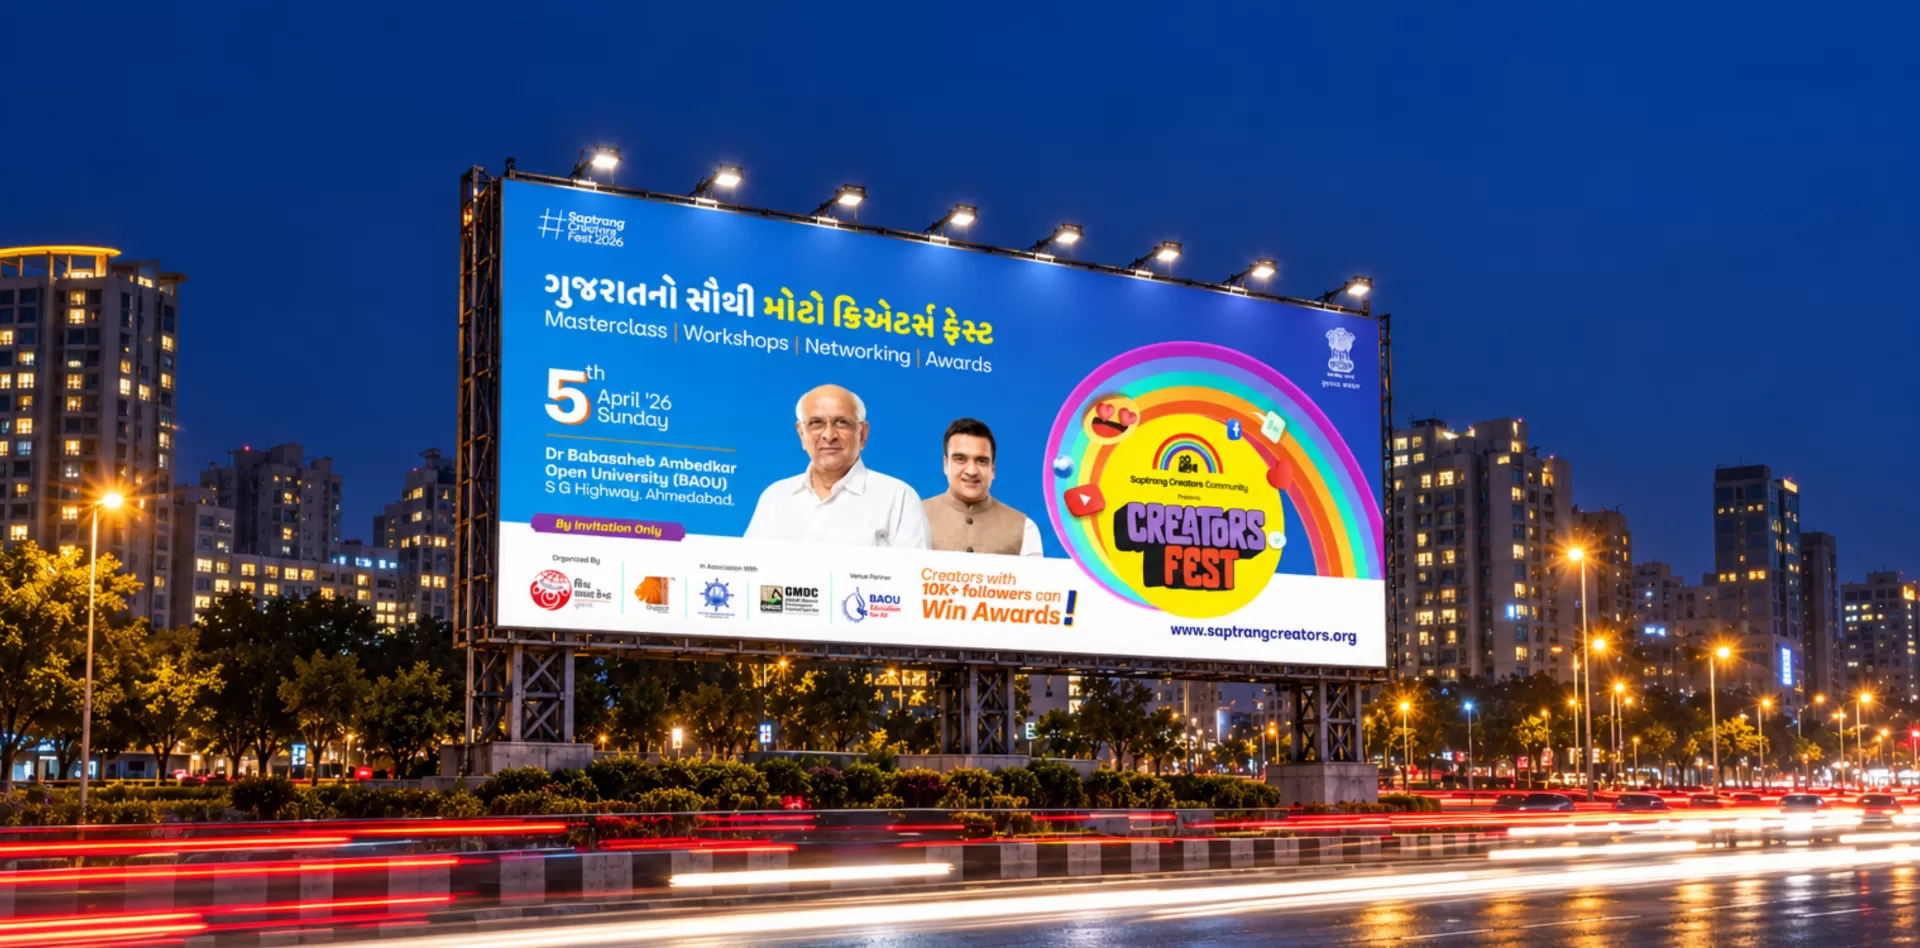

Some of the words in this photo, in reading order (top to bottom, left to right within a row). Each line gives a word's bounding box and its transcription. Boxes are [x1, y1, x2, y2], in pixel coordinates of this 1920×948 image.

[568, 211, 625, 231] Saptrang
[568, 231, 593, 244] Fest
[594, 234, 624, 247] 2026
[544, 273, 677, 309] ગુજરાતનો
[686, 277, 755, 318] સૌથી
[763, 286, 824, 325] મોટો
[833, 295, 936, 338] ક્રિએટર્સ
[942, 307, 994, 346] ફેસ્ટ
[545, 310, 668, 339] Masterclass
[683, 324, 789, 353] Workshops
[805, 338, 910, 368] Networking
[925, 351, 992, 373] Awards
[545, 368, 591, 425] 5
[585, 364, 605, 380] th
[597, 389, 640, 408] April
[645, 392, 672, 411] '26
[597, 407, 669, 431] Sunday
[545, 447, 564, 460] Dr
[567, 448, 655, 468] Babasaheb
[659, 456, 737, 474] Ambedkar
[545, 464, 587, 480] Open
[591, 467, 669, 488] University
[673, 473, 728, 491] (BAOU)
[1130, 475, 1168, 487] Saptrang
[1169, 478, 1203, 488] Creators
[1205, 481, 1248, 494] Community
[545, 481, 555, 494] S
[559, 481, 571, 495] G
[646, 489, 735, 506] Ahmedabad.
[556, 519, 572, 532] By
[574, 520, 632, 534] Invitation
[634, 524, 662, 538] Only
[590, 556, 601, 566] By
[1164, 545, 1240, 590] FEST
[921, 567, 983, 584] Creators
[986, 572, 1017, 586] with
[785, 586, 819, 598] GMDC
[869, 594, 901, 604] BAOU
[922, 582, 959, 597] 10K+
[962, 583, 1032, 601] followers
[1035, 590, 1061, 603] can
[922, 598, 967, 621] Win
[1171, 625, 1357, 646] www.saptrangcreators.org
